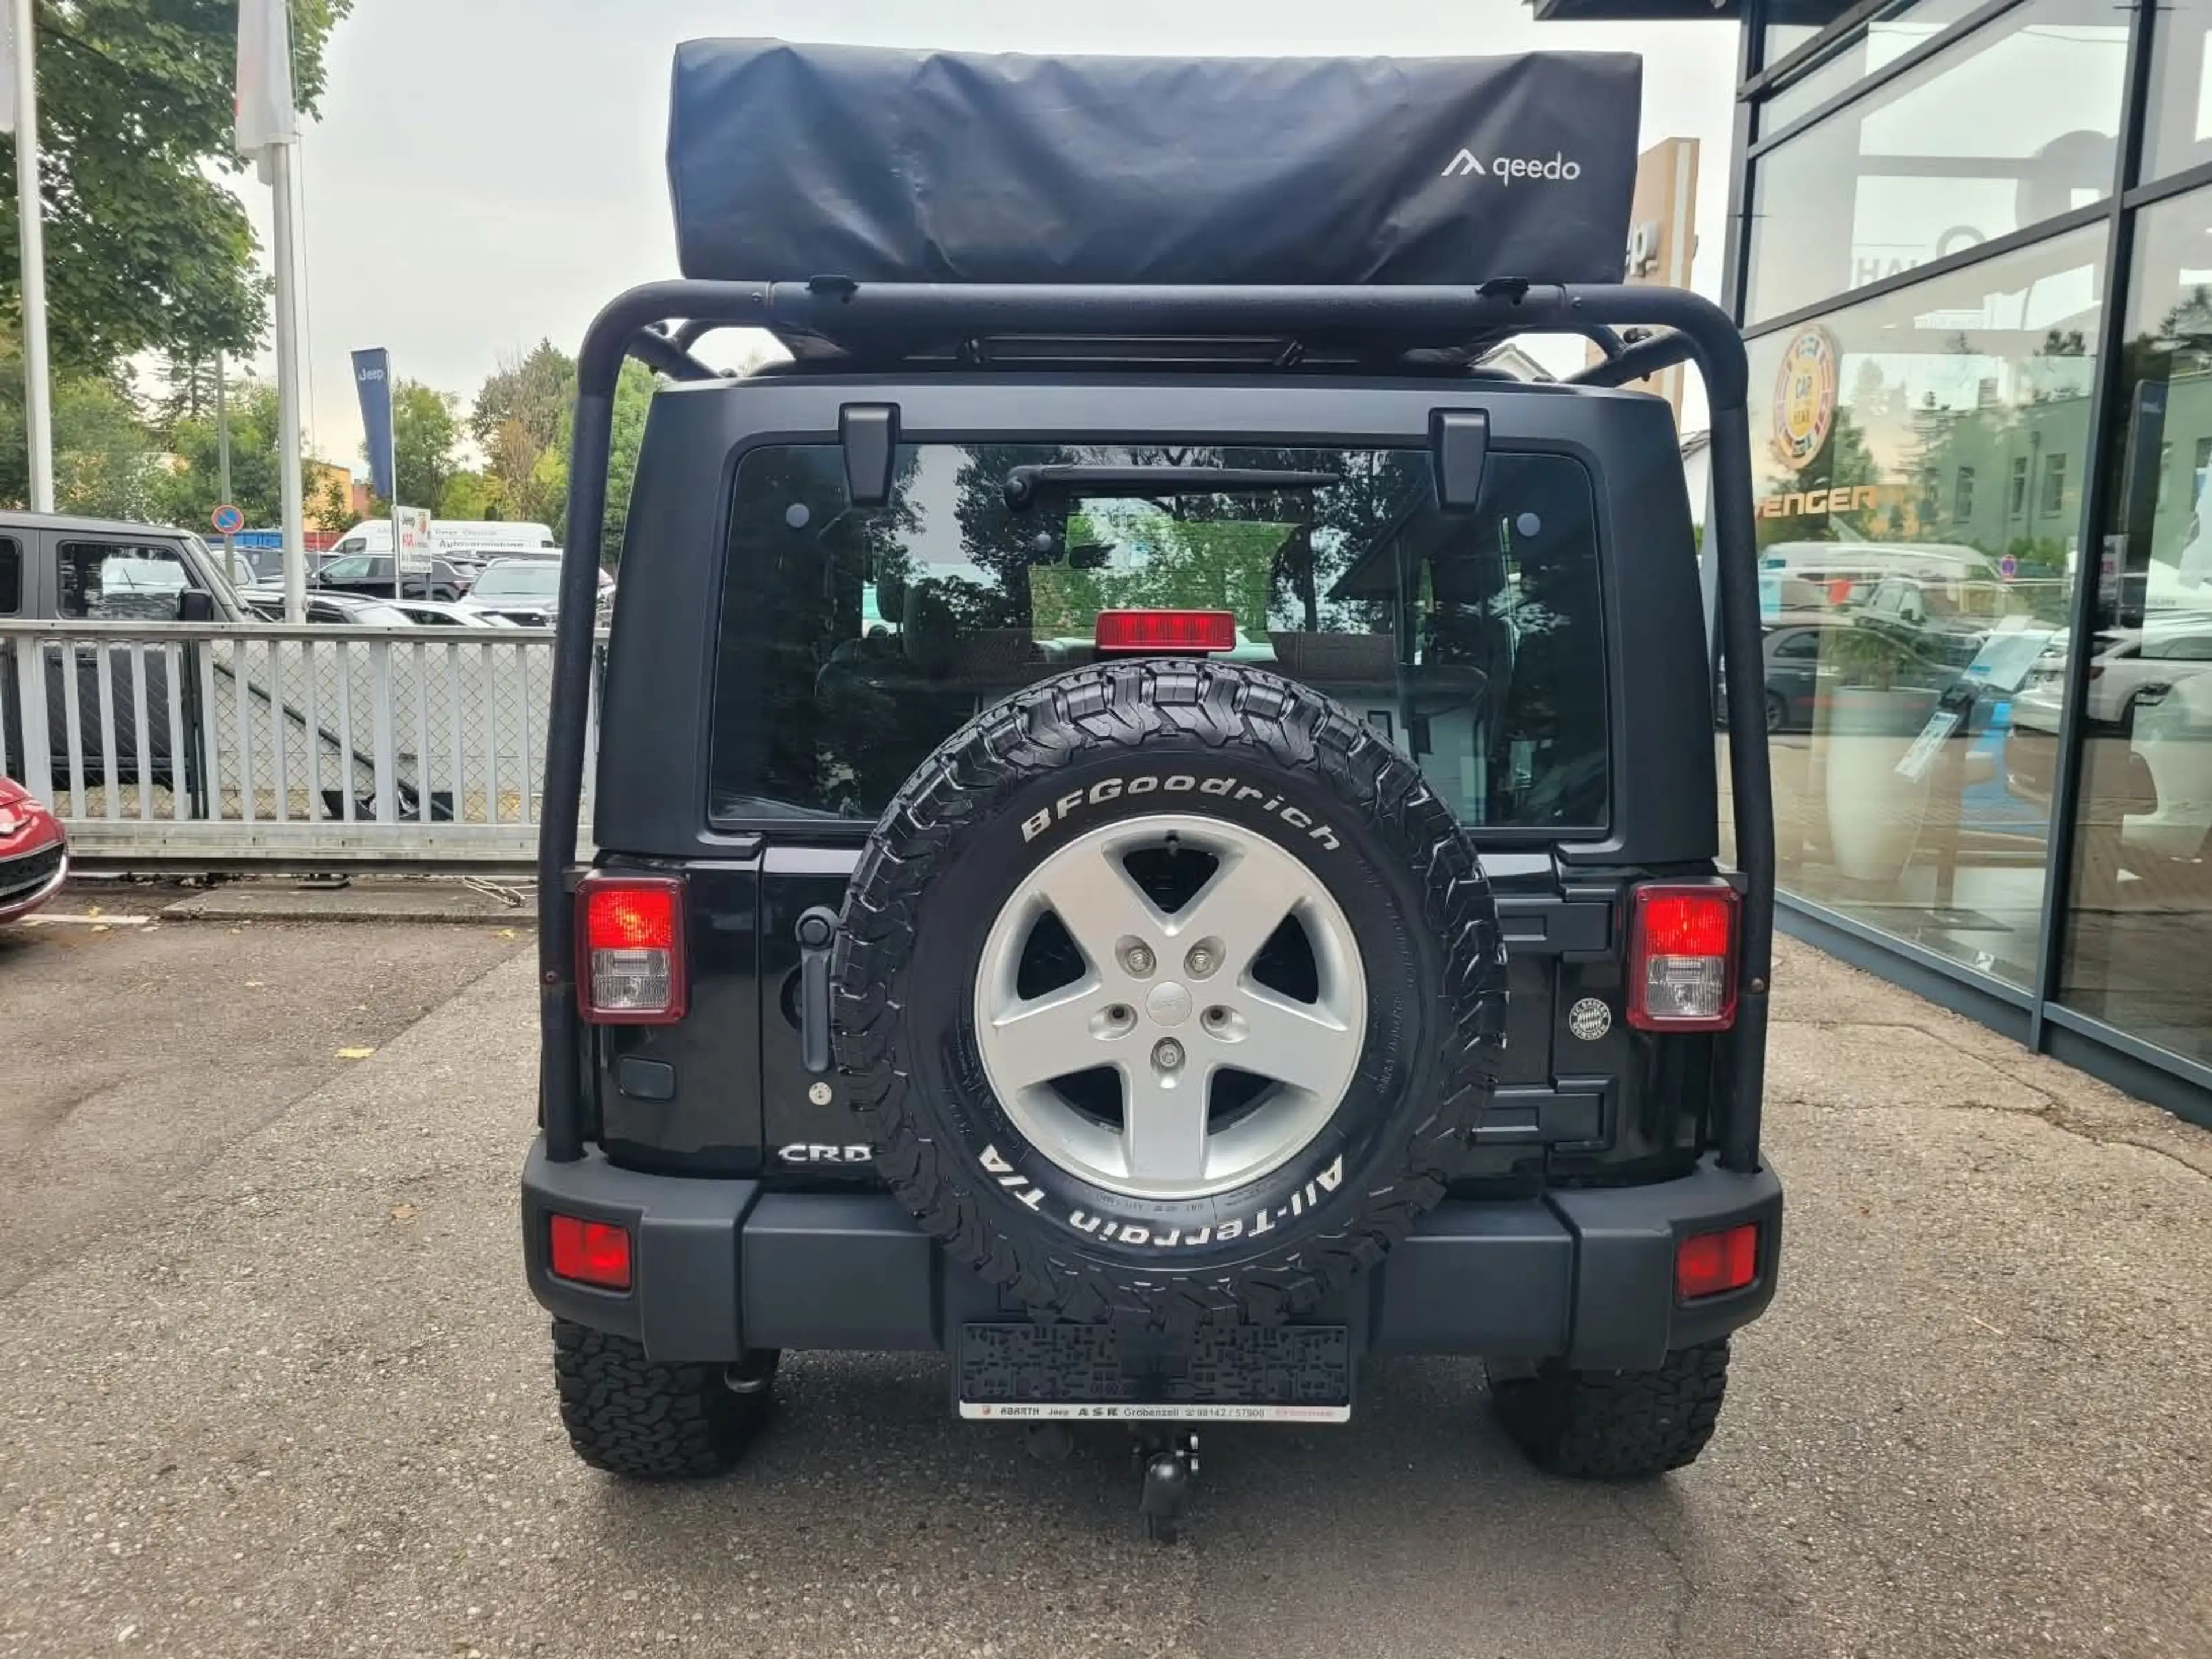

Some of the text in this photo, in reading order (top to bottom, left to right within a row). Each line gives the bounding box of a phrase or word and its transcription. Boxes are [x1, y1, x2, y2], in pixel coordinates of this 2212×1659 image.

[1493, 150, 1581, 188] qeedo
[358, 367, 384, 381] Jeep
[1021, 775, 1340, 851] BFGoodrich
[778, 1143, 872, 1162] CRD
[979, 1143, 1344, 1247] All-Terrain T/A
